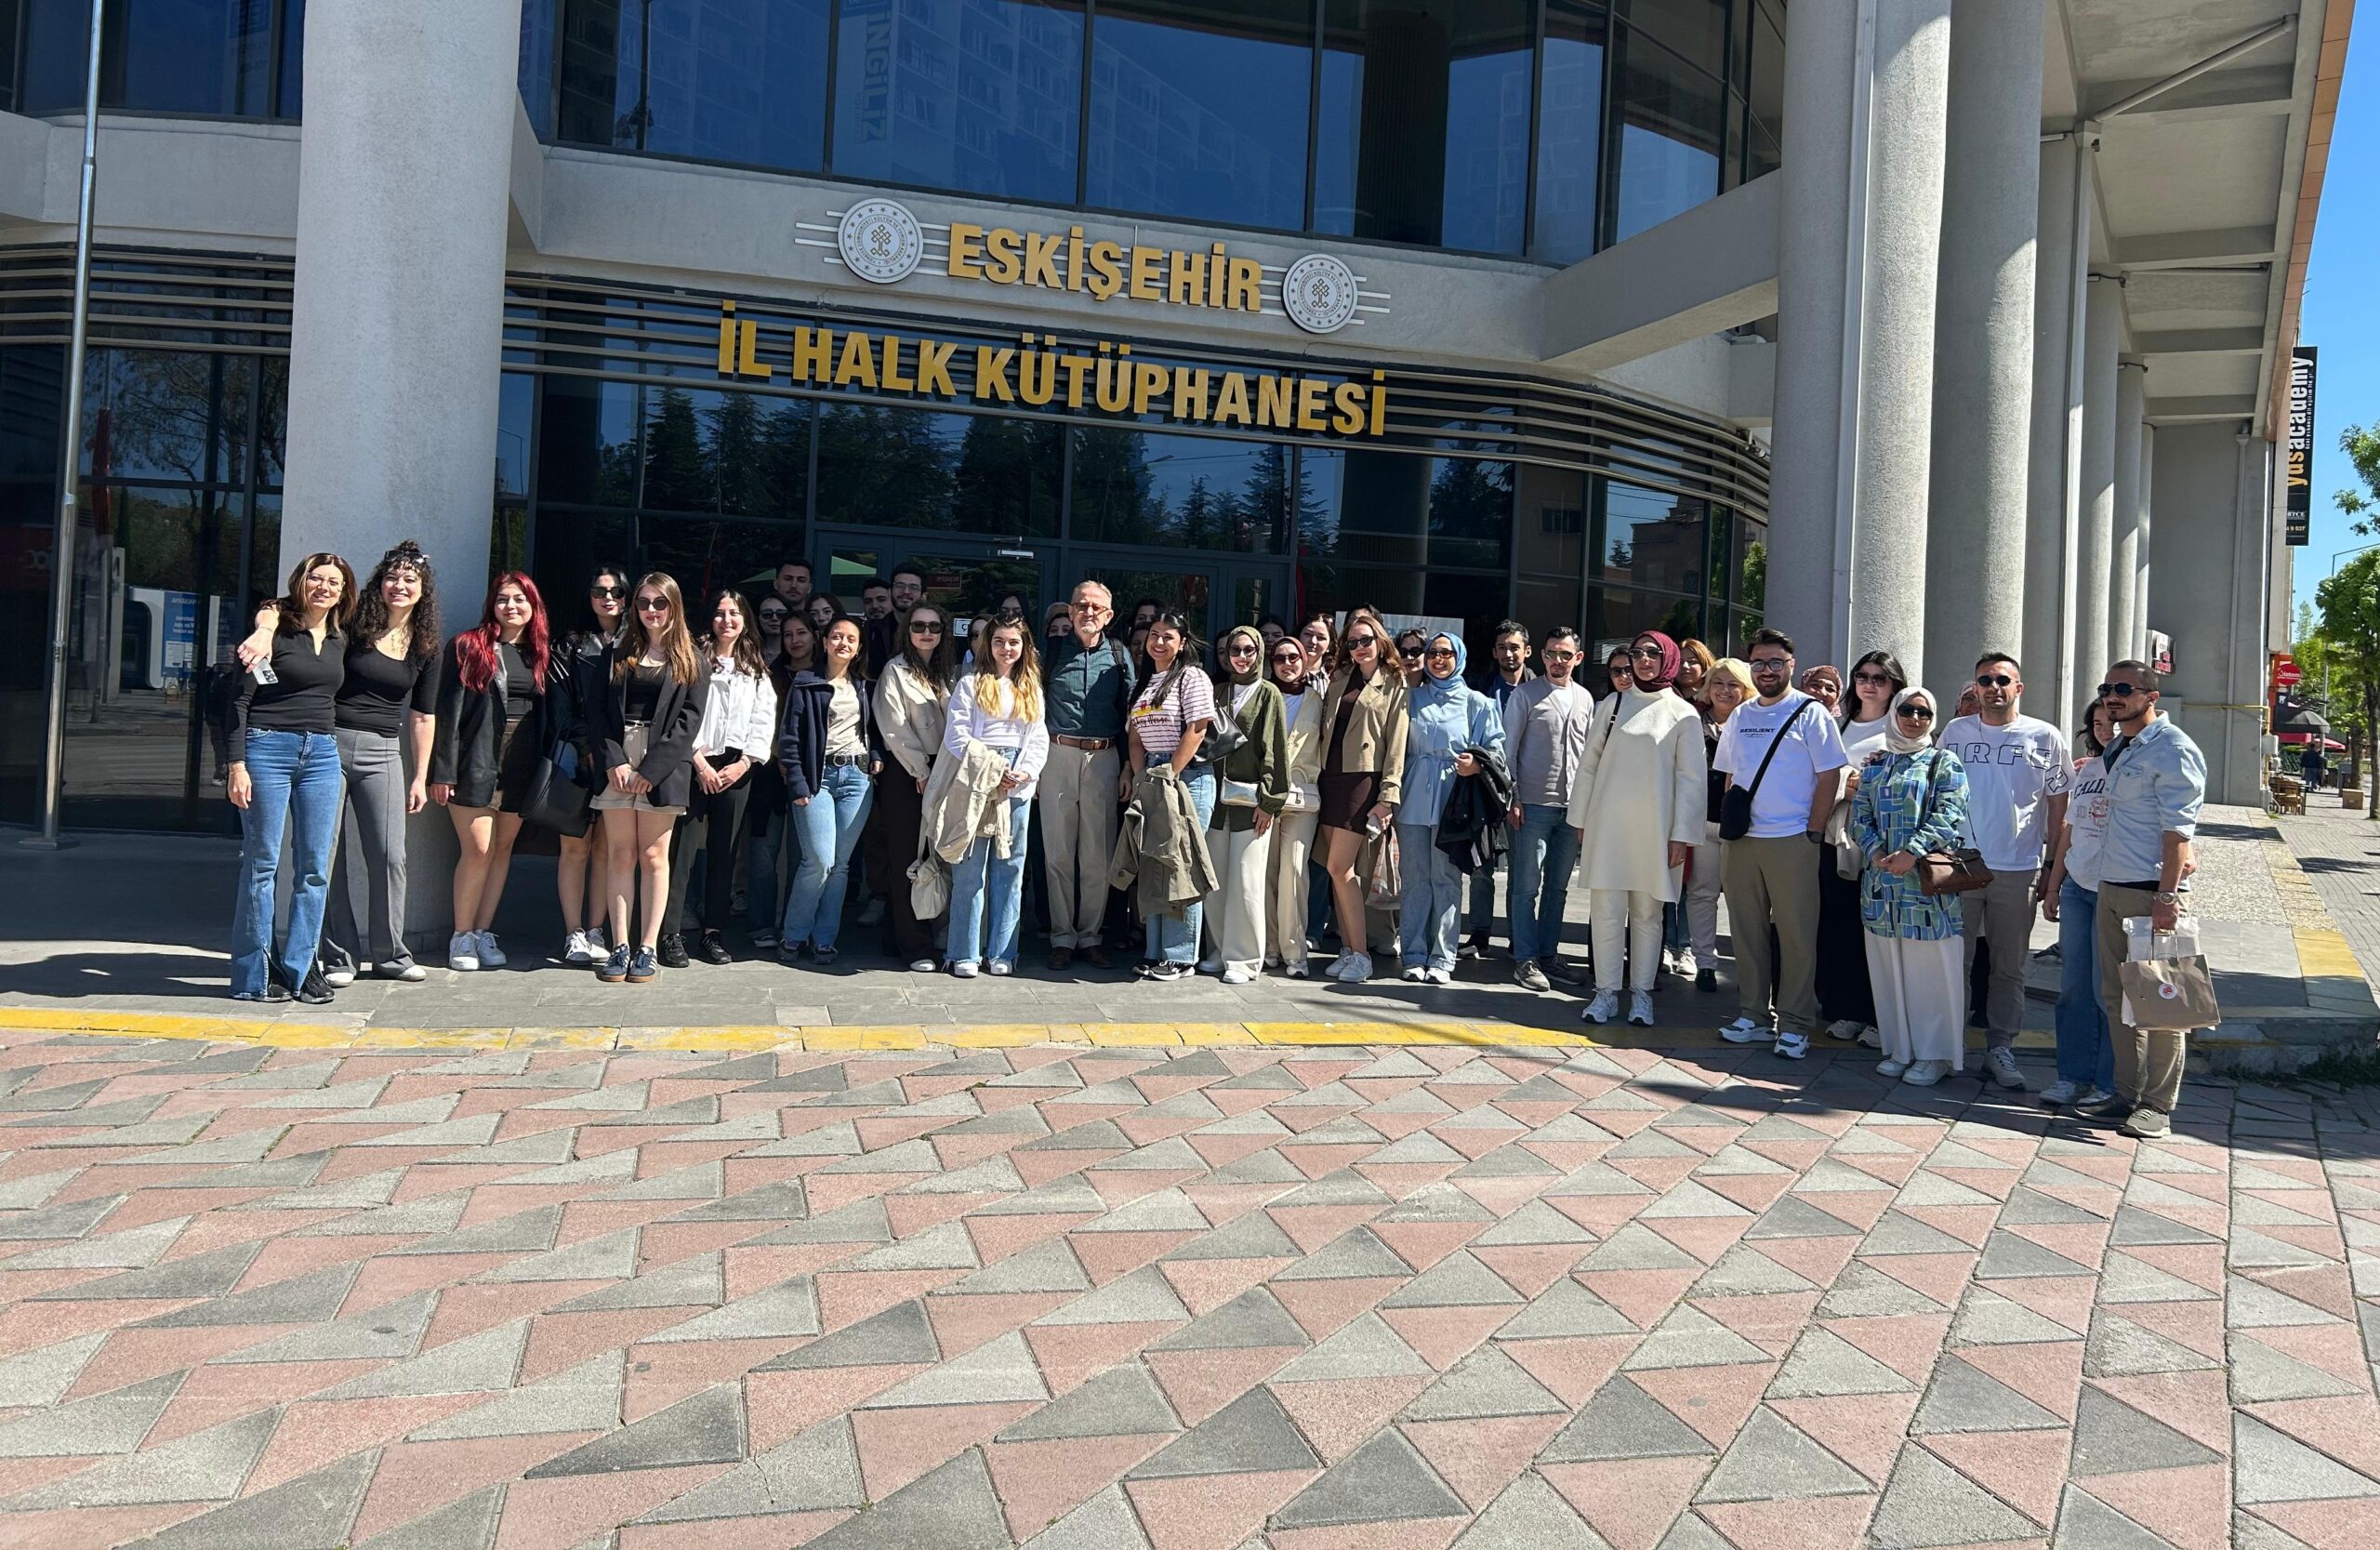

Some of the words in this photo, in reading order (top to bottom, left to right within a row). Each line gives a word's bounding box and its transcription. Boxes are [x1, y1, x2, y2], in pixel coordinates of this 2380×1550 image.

[948, 226, 1262, 311] ESKİŞEHİR
[719, 300, 772, 377] İL
[793, 326, 958, 396] HALK
[975, 333, 1386, 436] KÜTÜPHANESİ
